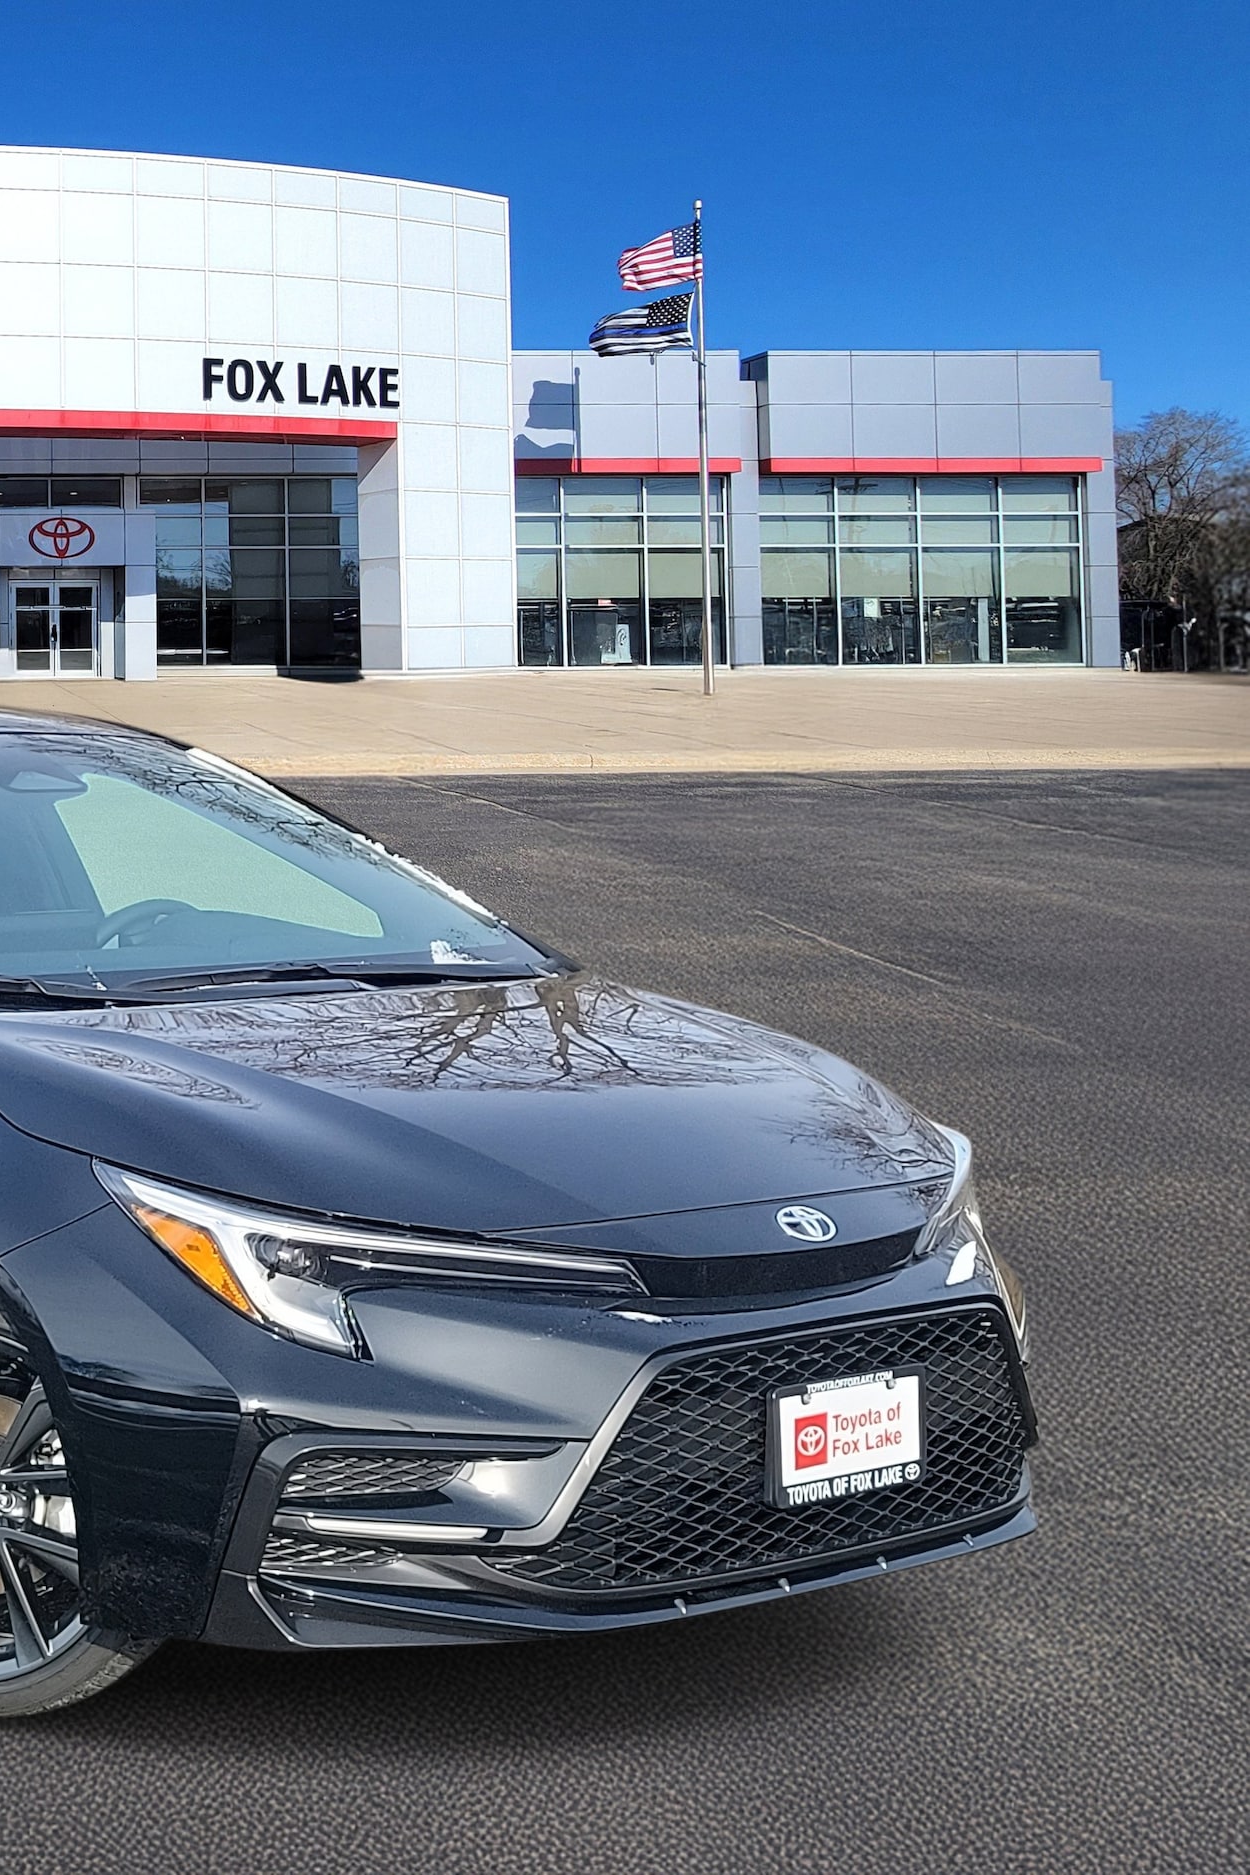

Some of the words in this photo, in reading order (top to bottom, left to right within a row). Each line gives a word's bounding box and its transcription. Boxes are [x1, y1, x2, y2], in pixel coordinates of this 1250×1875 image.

[202, 357, 285, 403] FOX
[297, 362, 400, 408] LAKE
[832, 1408, 882, 1434] Toyota
[887, 1402, 902, 1421] of
[832, 1439, 859, 1457] Fox
[865, 1429, 902, 1451] Lake
[787, 1480, 832, 1506] TOYOTA
[833, 1476, 849, 1496] OF
[850, 1471, 873, 1493] FOX
[874, 1465, 903, 1488] LAKE
